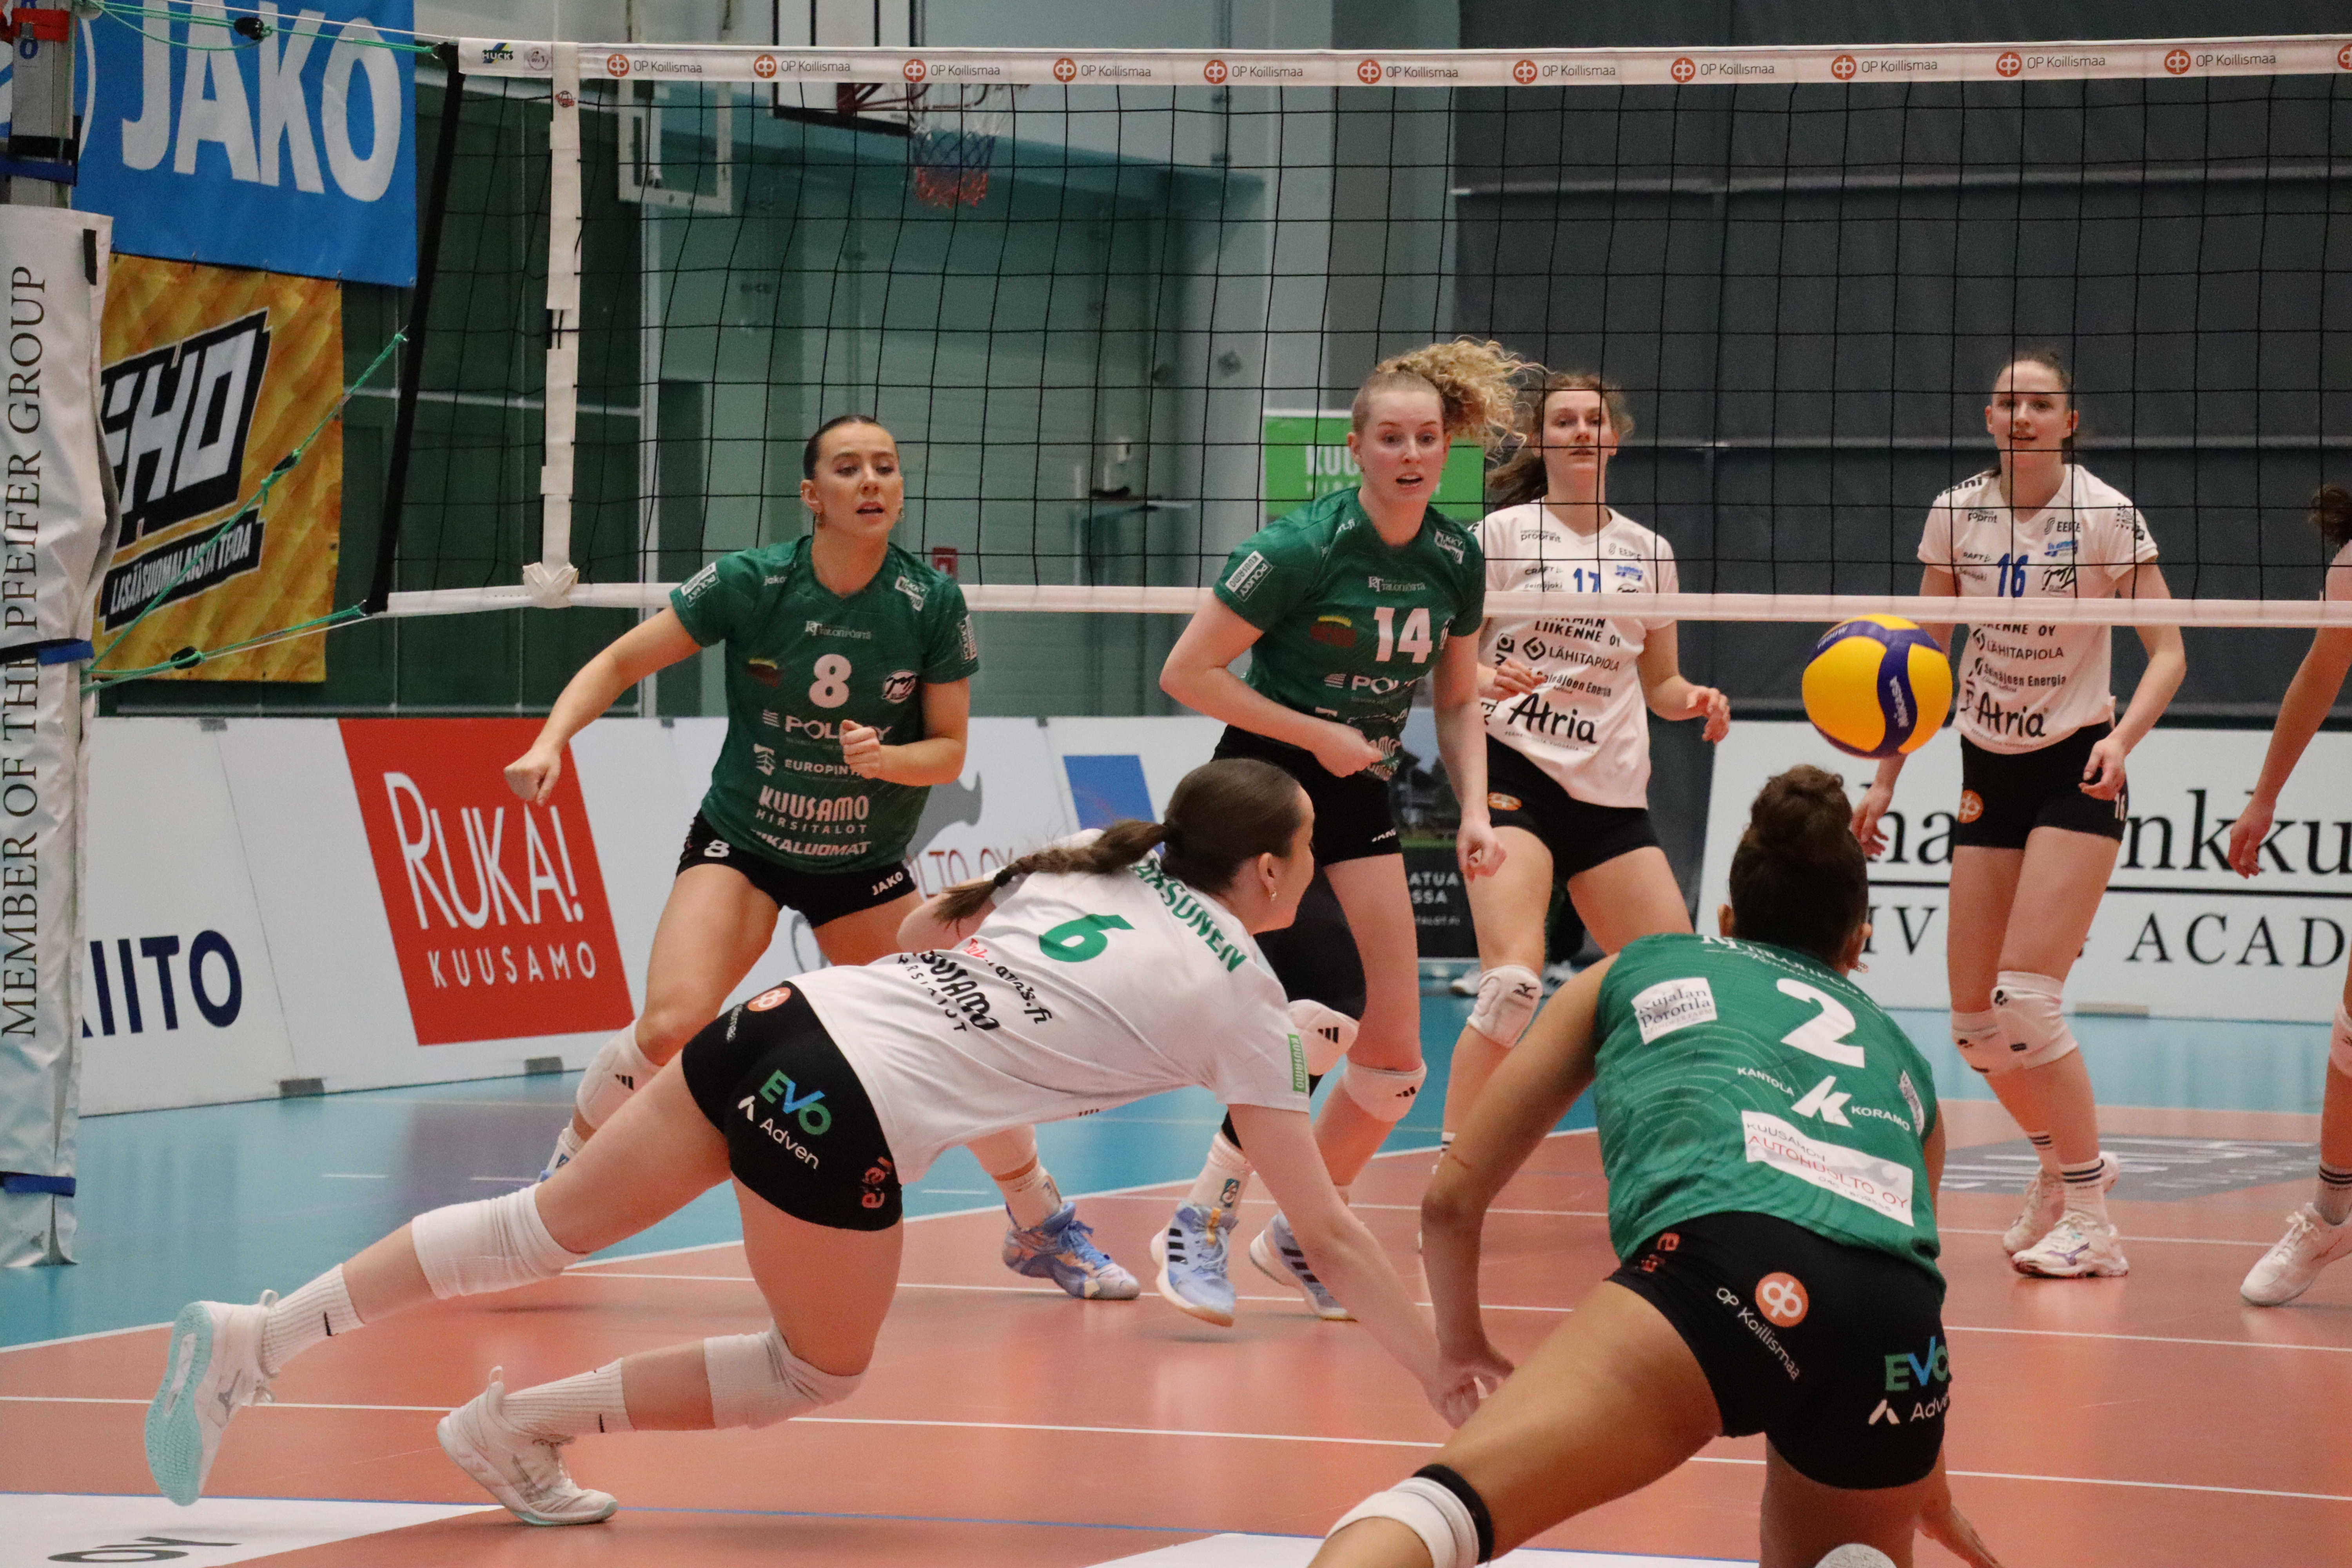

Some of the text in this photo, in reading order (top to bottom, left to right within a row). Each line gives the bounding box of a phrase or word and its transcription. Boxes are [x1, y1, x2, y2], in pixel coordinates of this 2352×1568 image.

[482, 51, 512, 60] HUCK
[634, 60, 702, 73] OP Koillismaa
[781, 60, 850, 73] OP Koillismaa
[931, 64, 1000, 75] OP Koillismaa
[1081, 65, 1151, 76] OP Koillismaa
[1232, 65, 1303, 77] OP Koillismaa
[1386, 65, 1458, 78] OP Koillismaa
[1543, 65, 1615, 76] OP Koillismaa
[1700, 63, 1774, 75] OP Koillismaa
[1862, 61, 1937, 73] OP Koillismaa
[2027, 56, 2105, 69] OP Koillismaa
[2196, 54, 2276, 66] OP Koillismaa
[122, 0, 401, 202] JAKO
[7, 267, 46, 434] GROUP
[2, 450, 41, 630] PFEIFER
[1229, 555, 1257, 587] KUUSAMO
[1573, 568, 1599, 593] 17
[1997, 553, 2028, 597] 16
[1374, 606, 1433, 663] 14
[1534, 620, 1602, 642] LIIKENNE
[2038, 625, 2056, 636] OY
[1549, 646, 1620, 672] LÄHITAPIOLA
[1987, 641, 2064, 660] LÄHITAPIOLA
[808, 653, 852, 708] 8
[2028, 675, 2067, 687] Energia
[785, 715, 893, 741] POLY
[1507, 693, 1597, 744] Atria
[1977, 691, 2047, 737] Atria
[785, 759, 857, 776] EUROPIN
[2, 757, 38, 819] OF
[759, 785, 869, 822] KUUSAMO
[755, 809, 867, 834] HIRSITALOT
[383, 771, 583, 930] RUKA!
[704, 839, 730, 858] 8
[751, 829, 871, 856] KALUOMAT
[871, 871, 904, 896] JAKO
[1136, 857, 1248, 973] AKSUNEN
[2, 831, 38, 1038] MEMBER
[1038, 913, 1136, 963] 6
[2124, 910, 2346, 968] ACAD
[427, 941, 597, 988] KUUSAMO
[1641, 998, 1710, 1028] Porotila
[1776, 978, 1866, 1069] 2
[1291, 1040, 1305, 1089] KUUSAMO
[759, 1069, 832, 1136] EVO
[1737, 1067, 1795, 1097] KANTOLA
[1851, 1106, 1910, 1132] KORAMO
[759, 1118, 819, 1169] Adven
[1746, 1123, 1826, 1162] KUUSAMON
[1748, 1135, 1908, 1208] AUTOHUOLTO OY
[1716, 1287, 1800, 1381] OP Koillismaa
[1884, 1336, 1949, 1392] EVO
